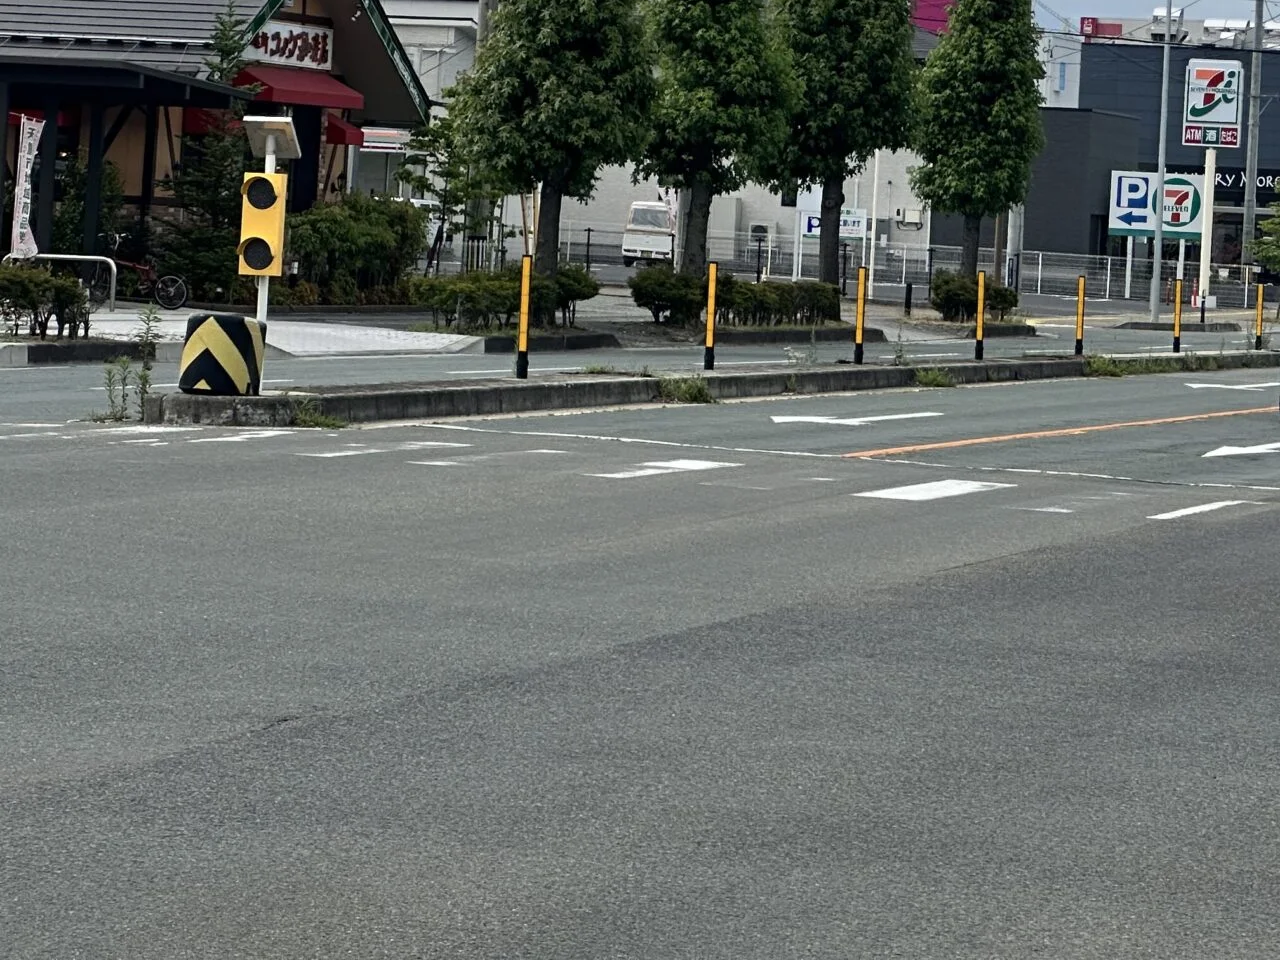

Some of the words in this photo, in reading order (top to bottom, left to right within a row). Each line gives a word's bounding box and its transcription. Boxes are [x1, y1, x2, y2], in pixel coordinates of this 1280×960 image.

[1185, 128, 1202, 141] ATM
[1205, 129, 1217, 142] 酒
[1221, 130, 1237, 143] たばこ
[1120, 177, 1147, 208] P
